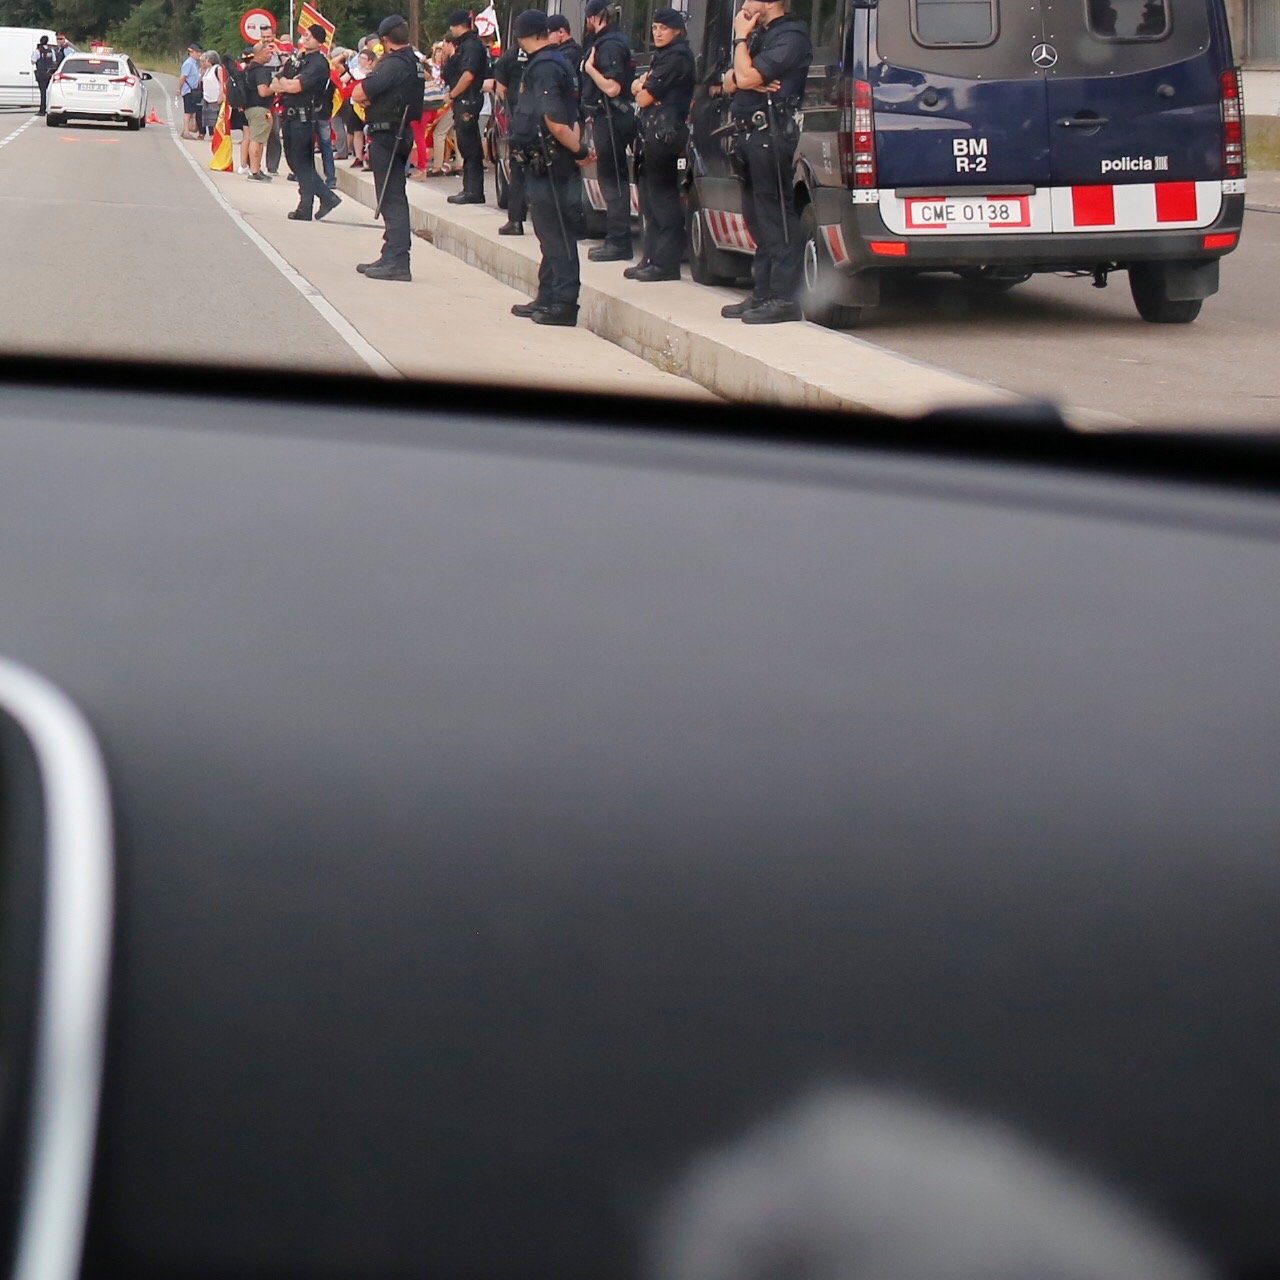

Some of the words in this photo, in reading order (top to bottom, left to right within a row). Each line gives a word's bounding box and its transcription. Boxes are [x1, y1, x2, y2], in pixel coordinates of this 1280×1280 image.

[953, 138, 987, 156] BM
[956, 156, 987, 172] R-2
[1101, 156, 1152, 173] policia
[921, 205, 956, 221] CME
[963, 204, 1010, 220] 0138
